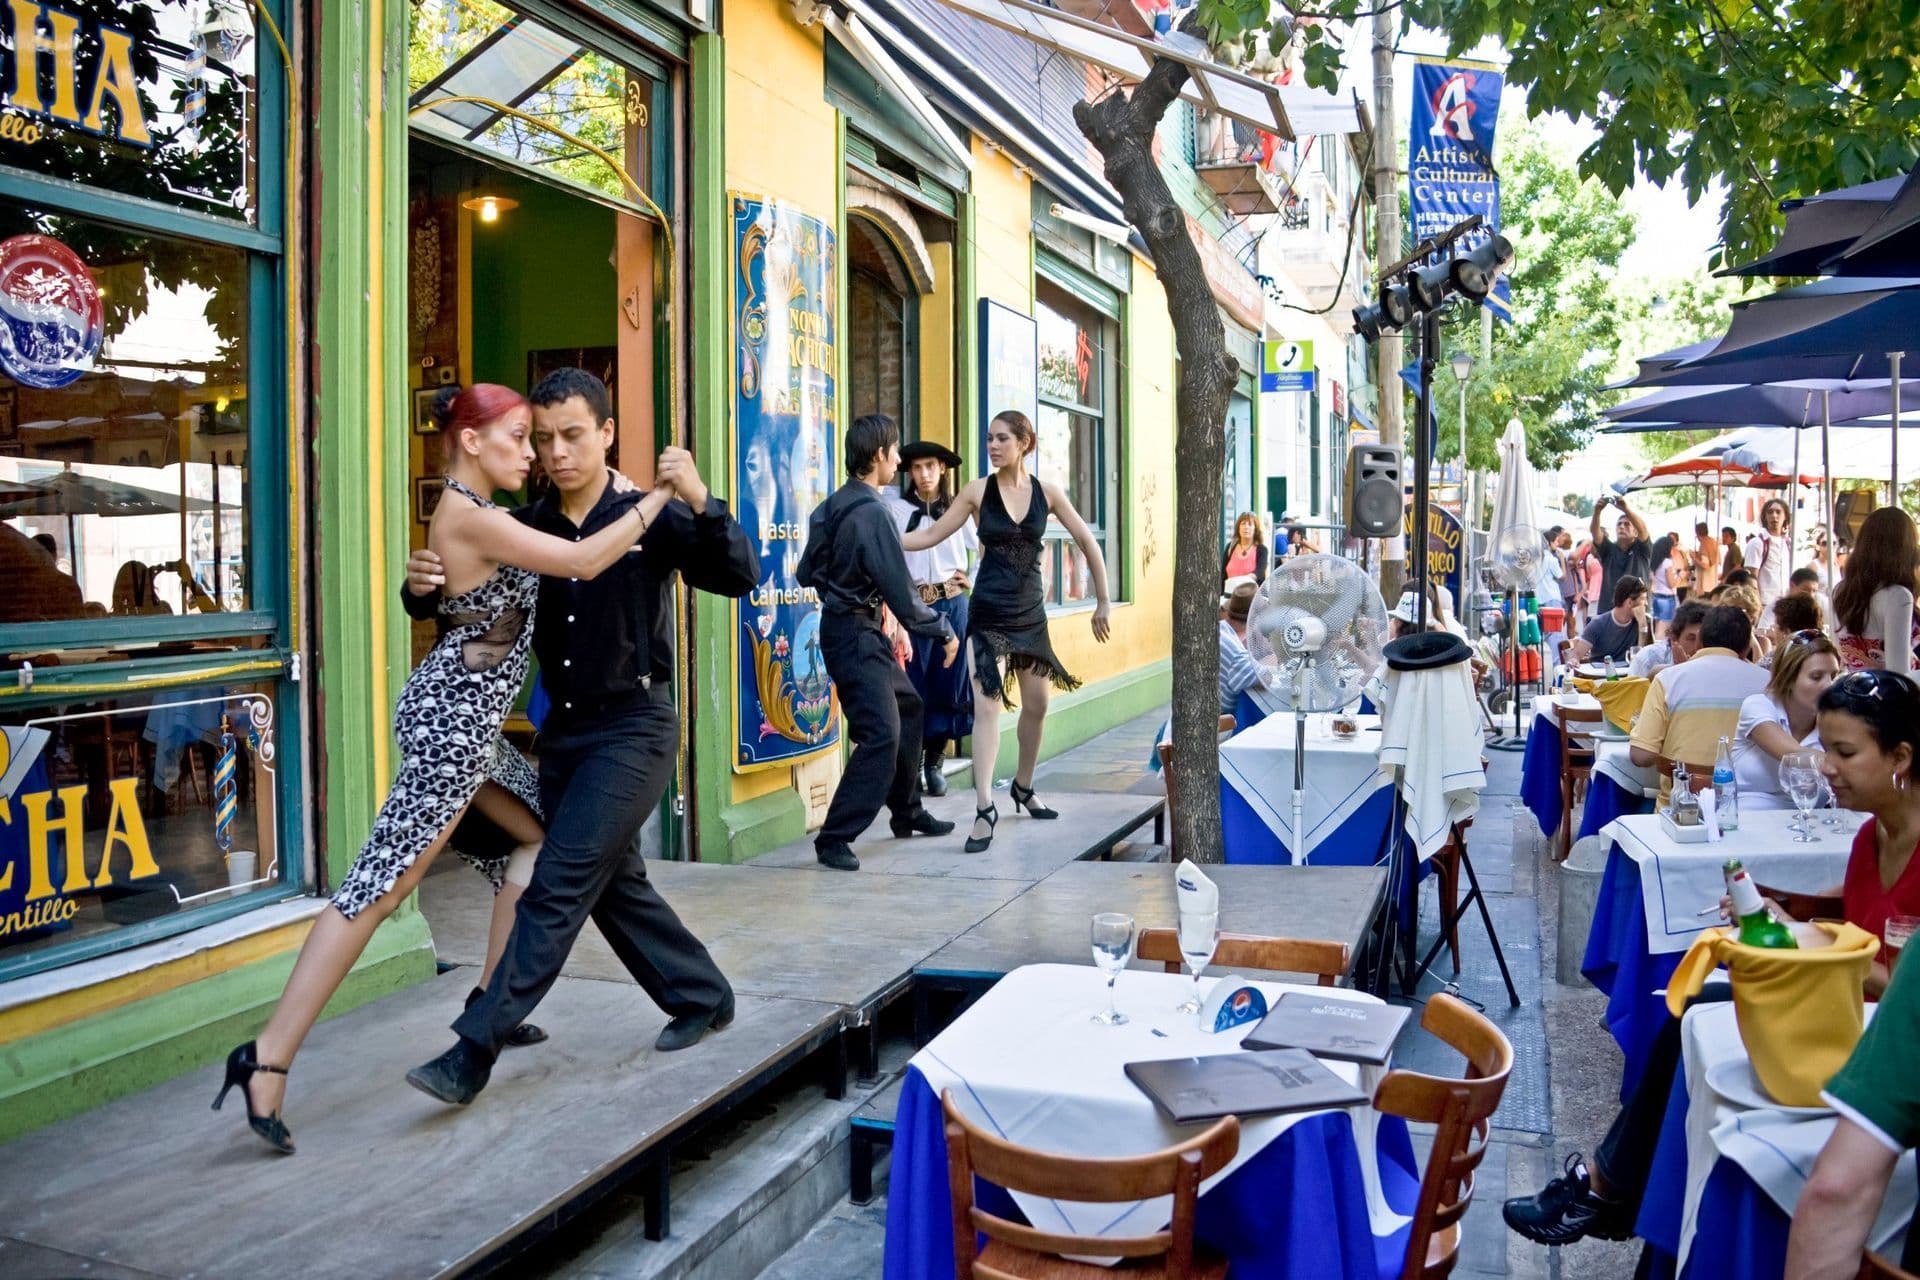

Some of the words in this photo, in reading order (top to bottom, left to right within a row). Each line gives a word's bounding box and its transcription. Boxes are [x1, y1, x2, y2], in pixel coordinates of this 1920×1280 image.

[1415, 145, 1489, 166] Artist's
[1415, 166, 1494, 185] Cultural
[1415, 185, 1495, 205] Center
